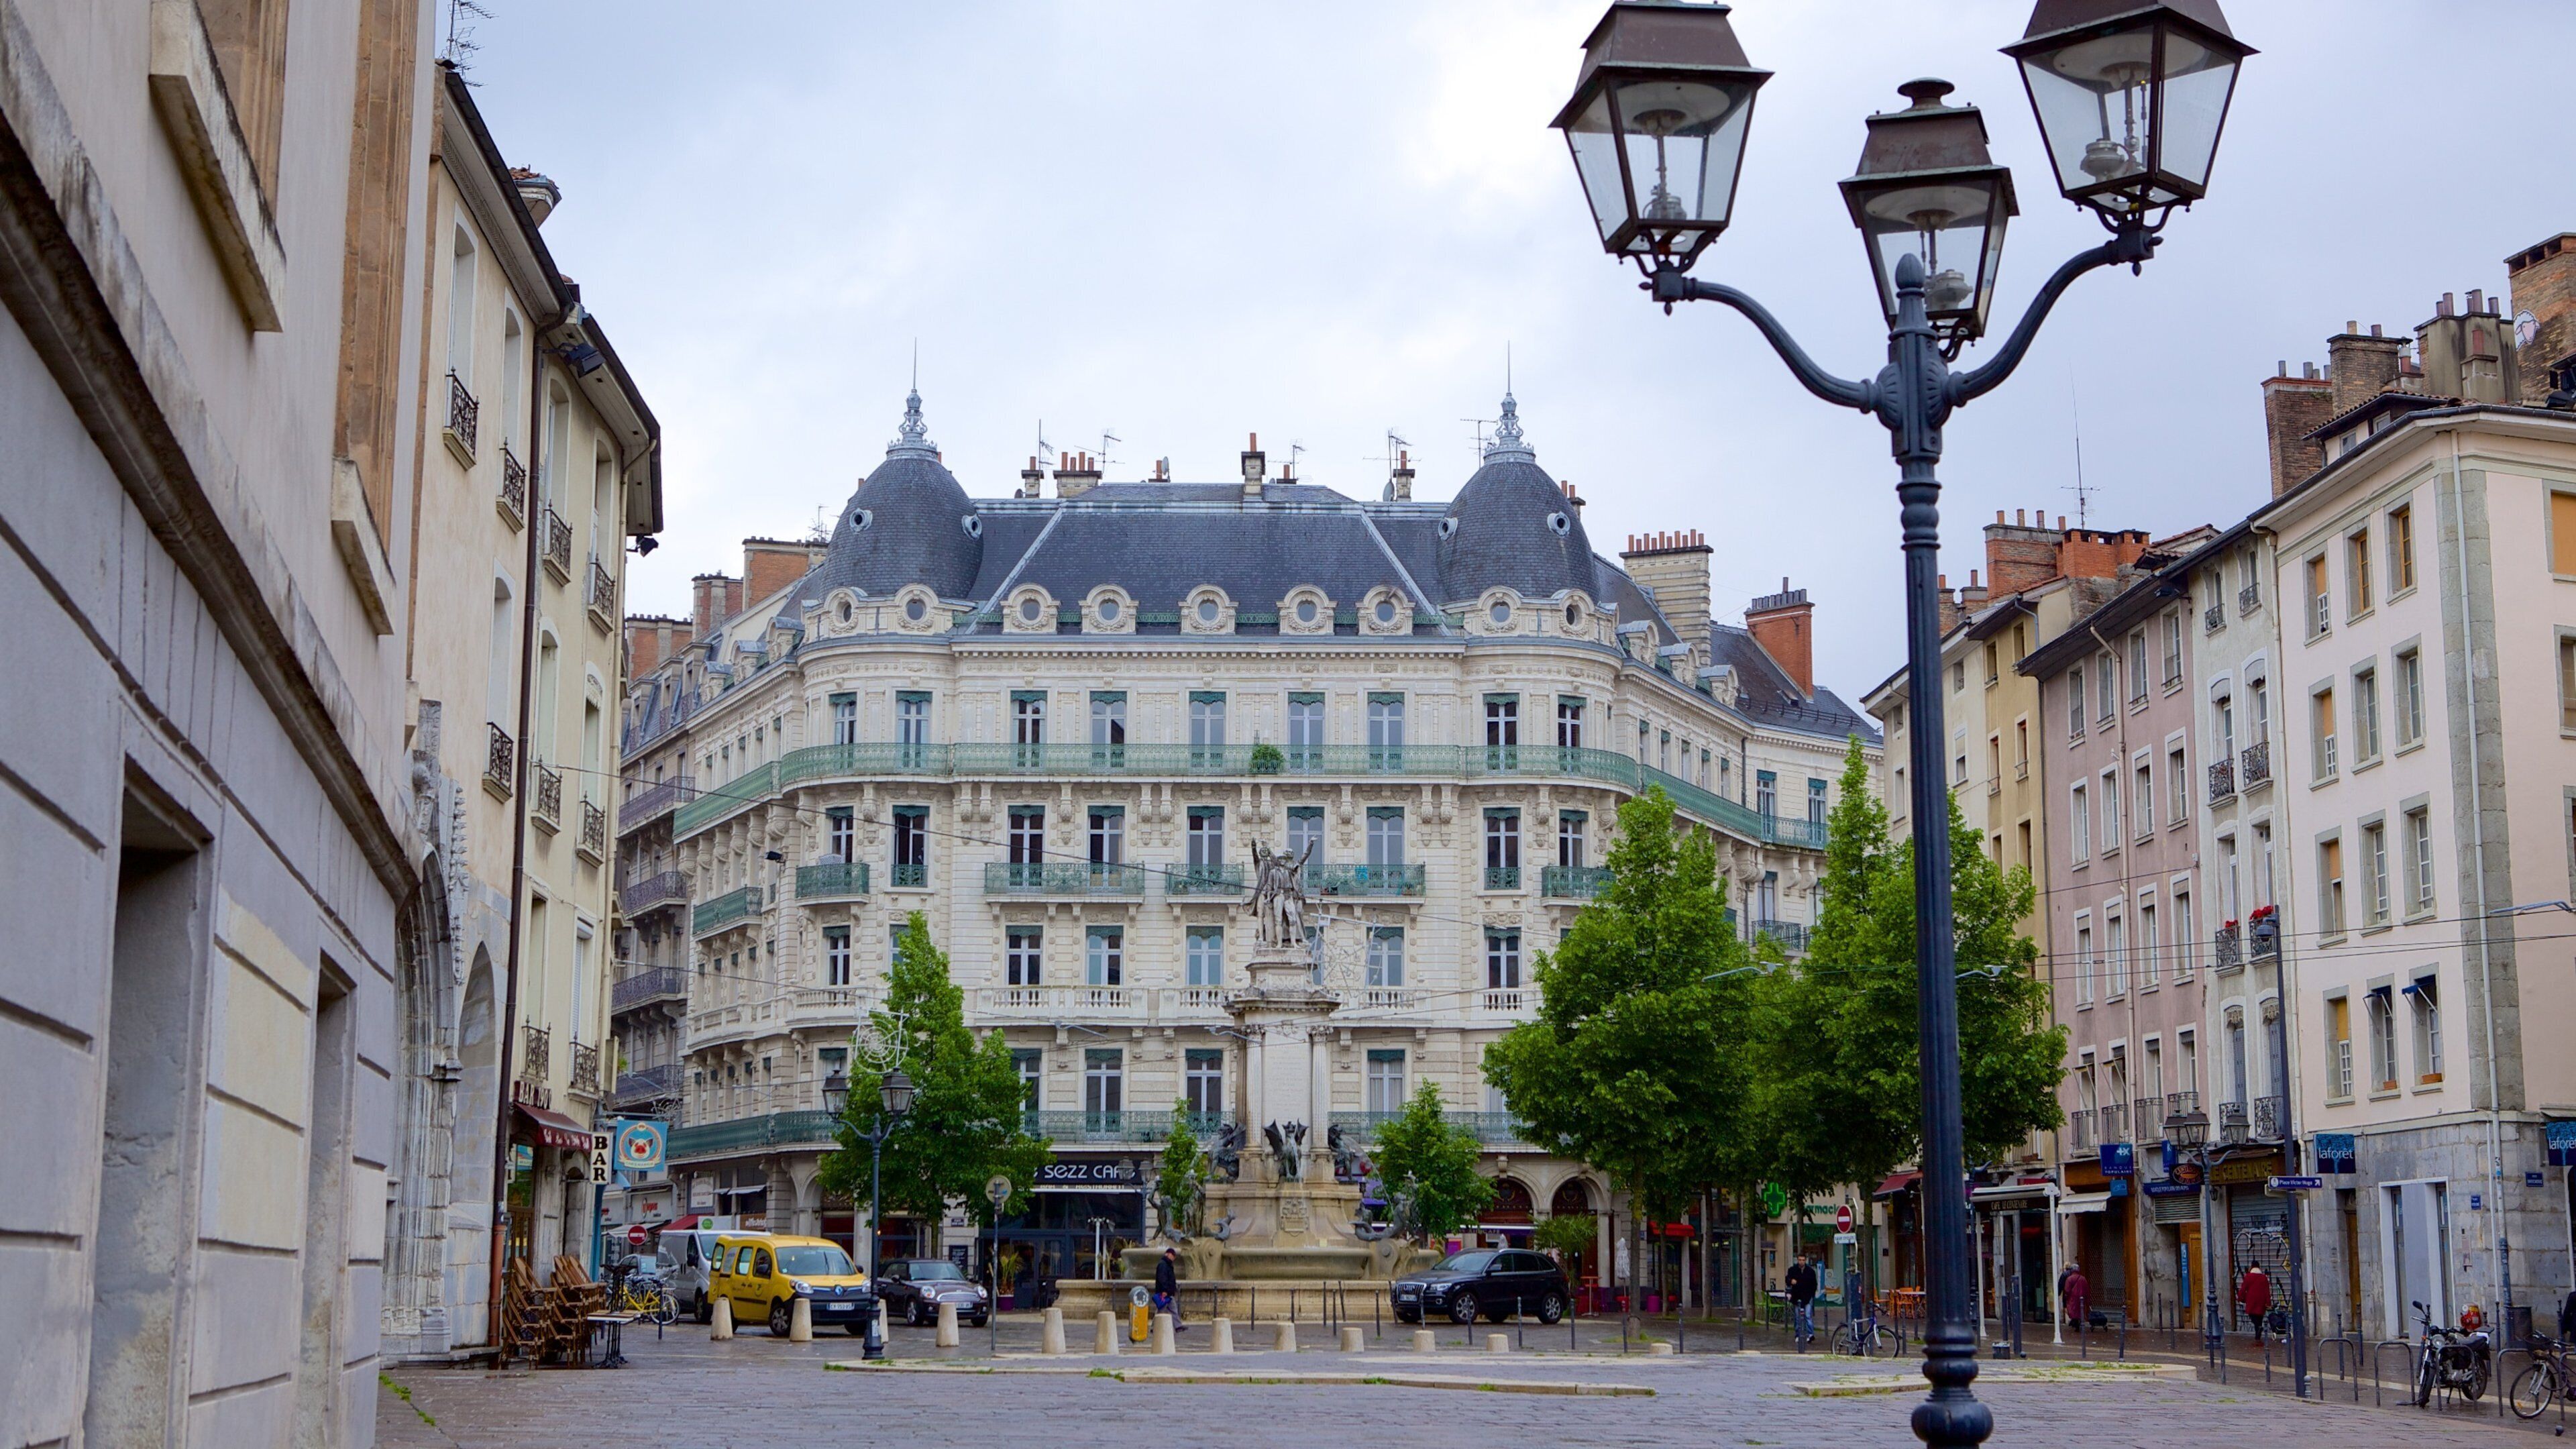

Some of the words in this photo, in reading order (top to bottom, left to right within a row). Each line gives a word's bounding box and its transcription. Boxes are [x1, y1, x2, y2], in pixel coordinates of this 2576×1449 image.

[518, 1081, 535, 1106] BAR
[592, 1136, 608, 1181] BAR
[2318, 1146, 2354, 1159] laforêt
